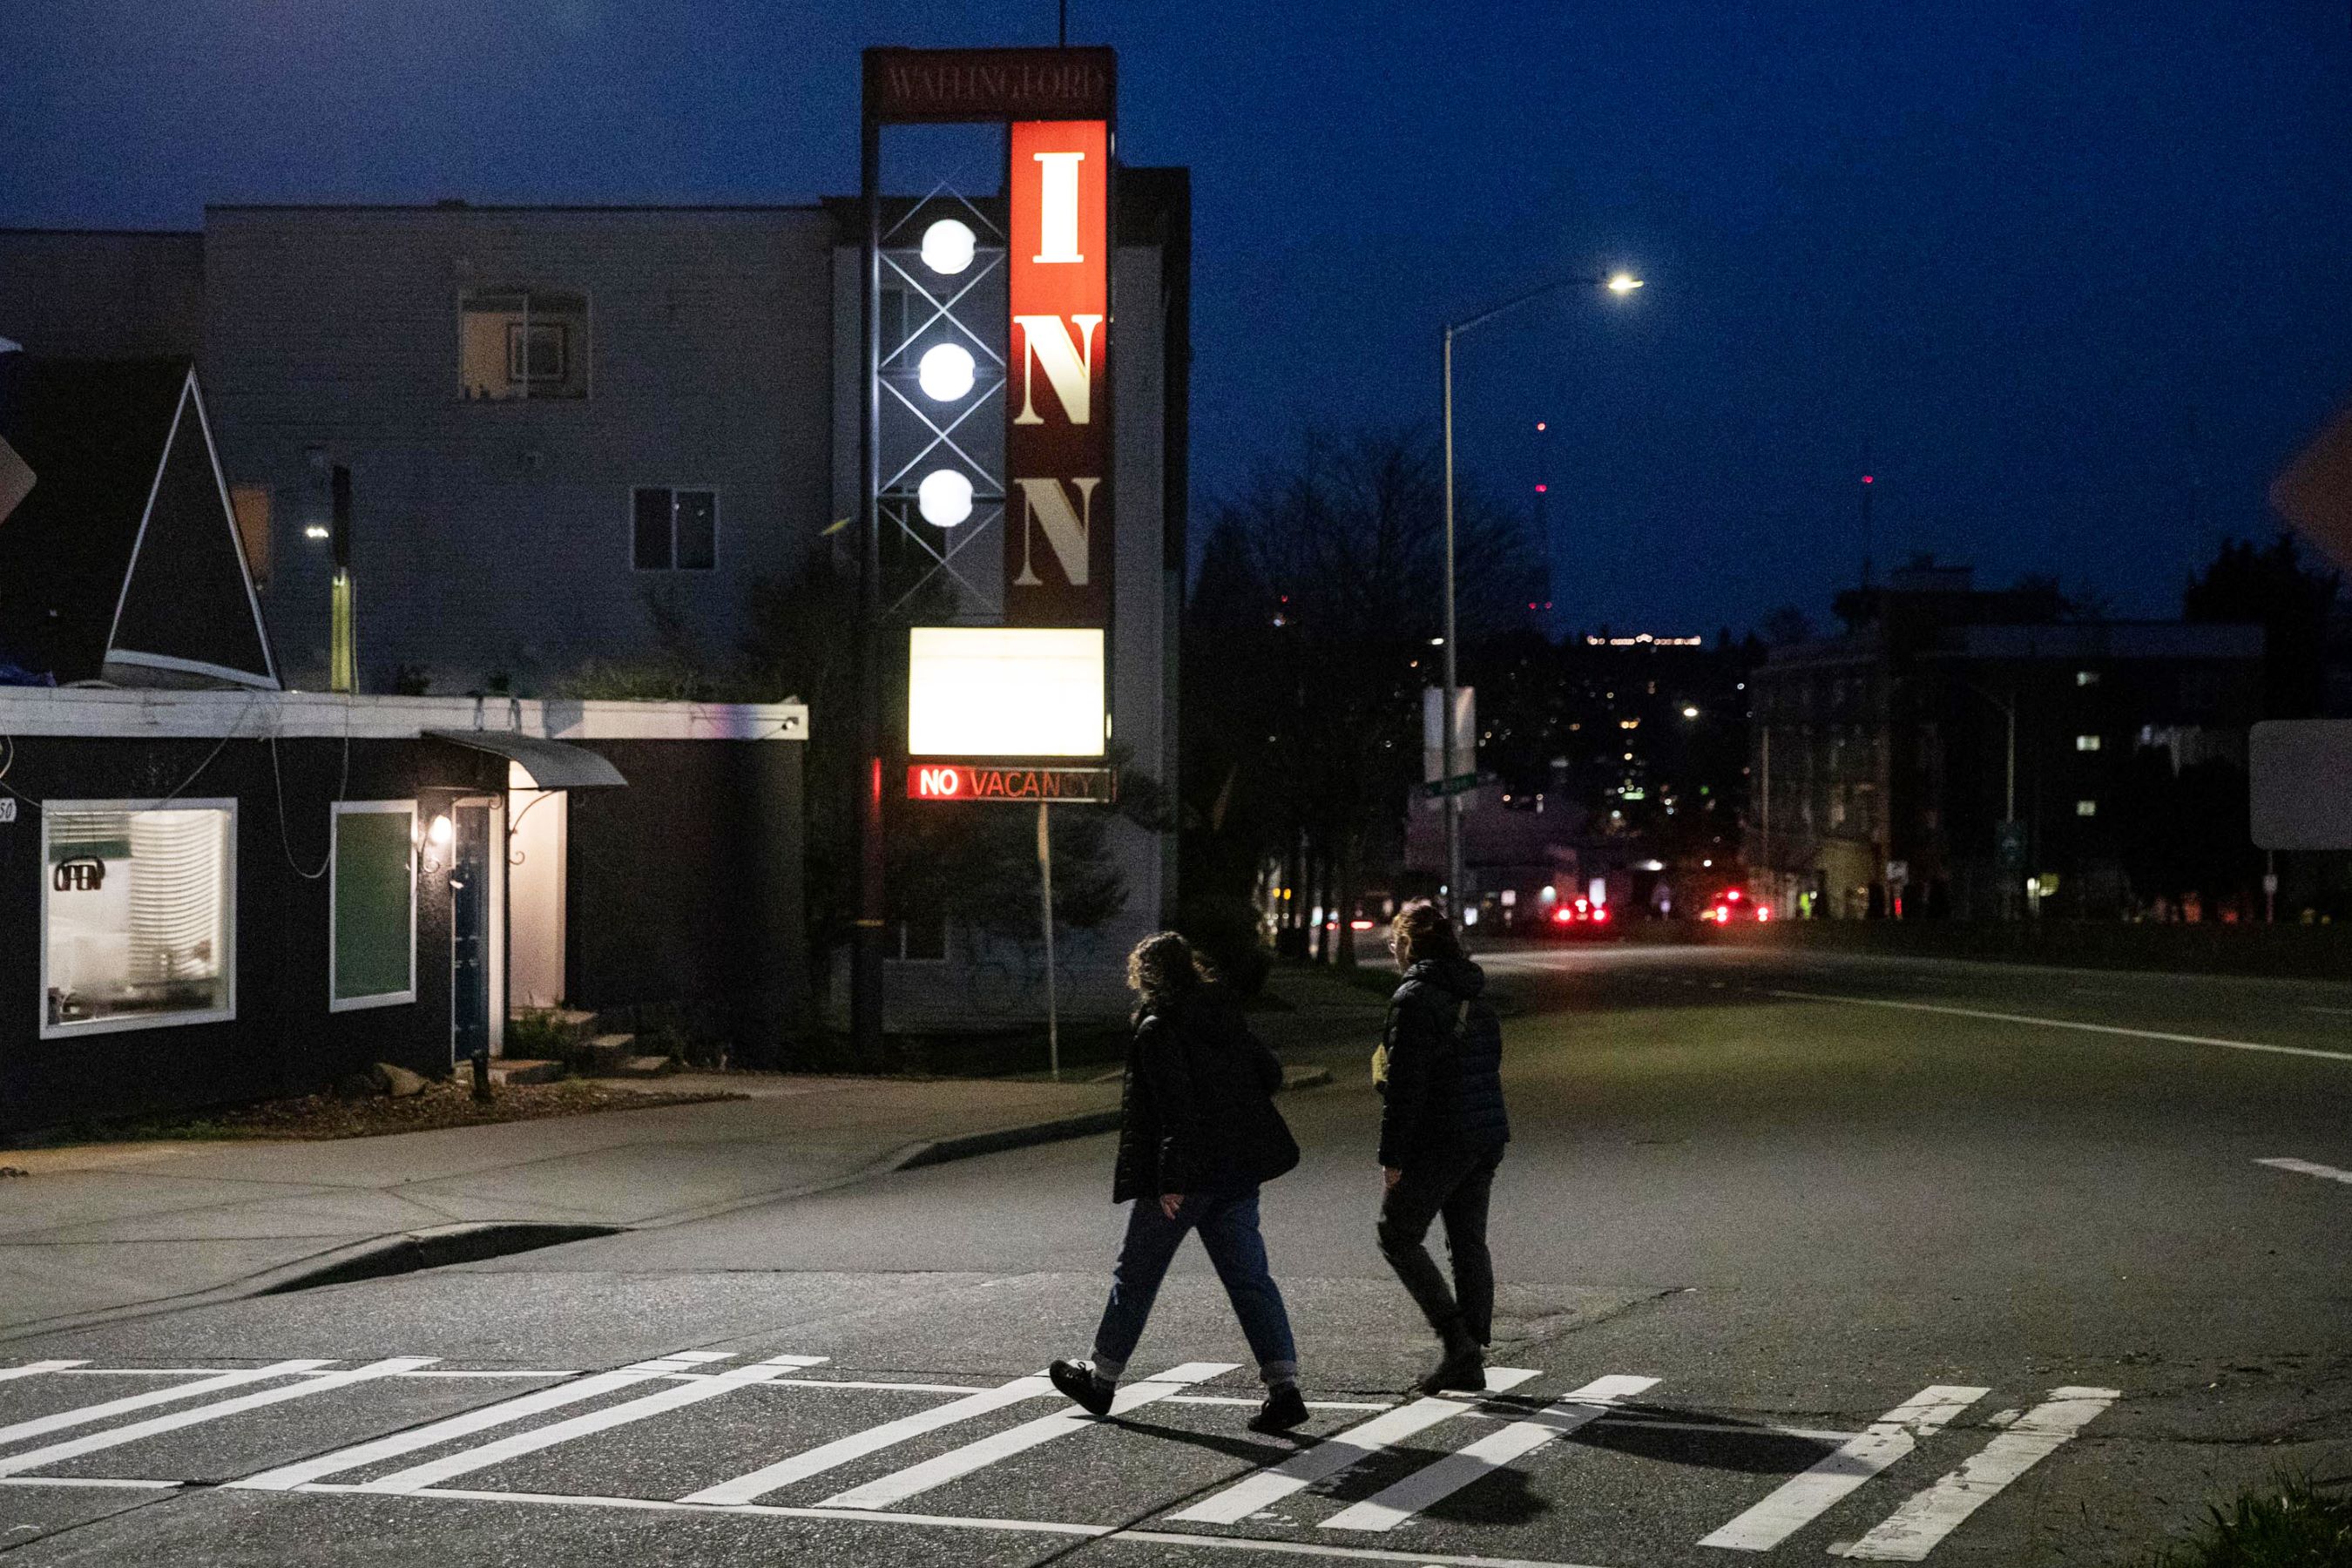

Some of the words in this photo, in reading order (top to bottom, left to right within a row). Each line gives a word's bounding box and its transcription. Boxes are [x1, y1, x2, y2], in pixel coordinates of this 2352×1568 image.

[1013, 152, 1103, 585] INN
[920, 768, 959, 796] NO
[970, 771, 1094, 798] VACANCY
